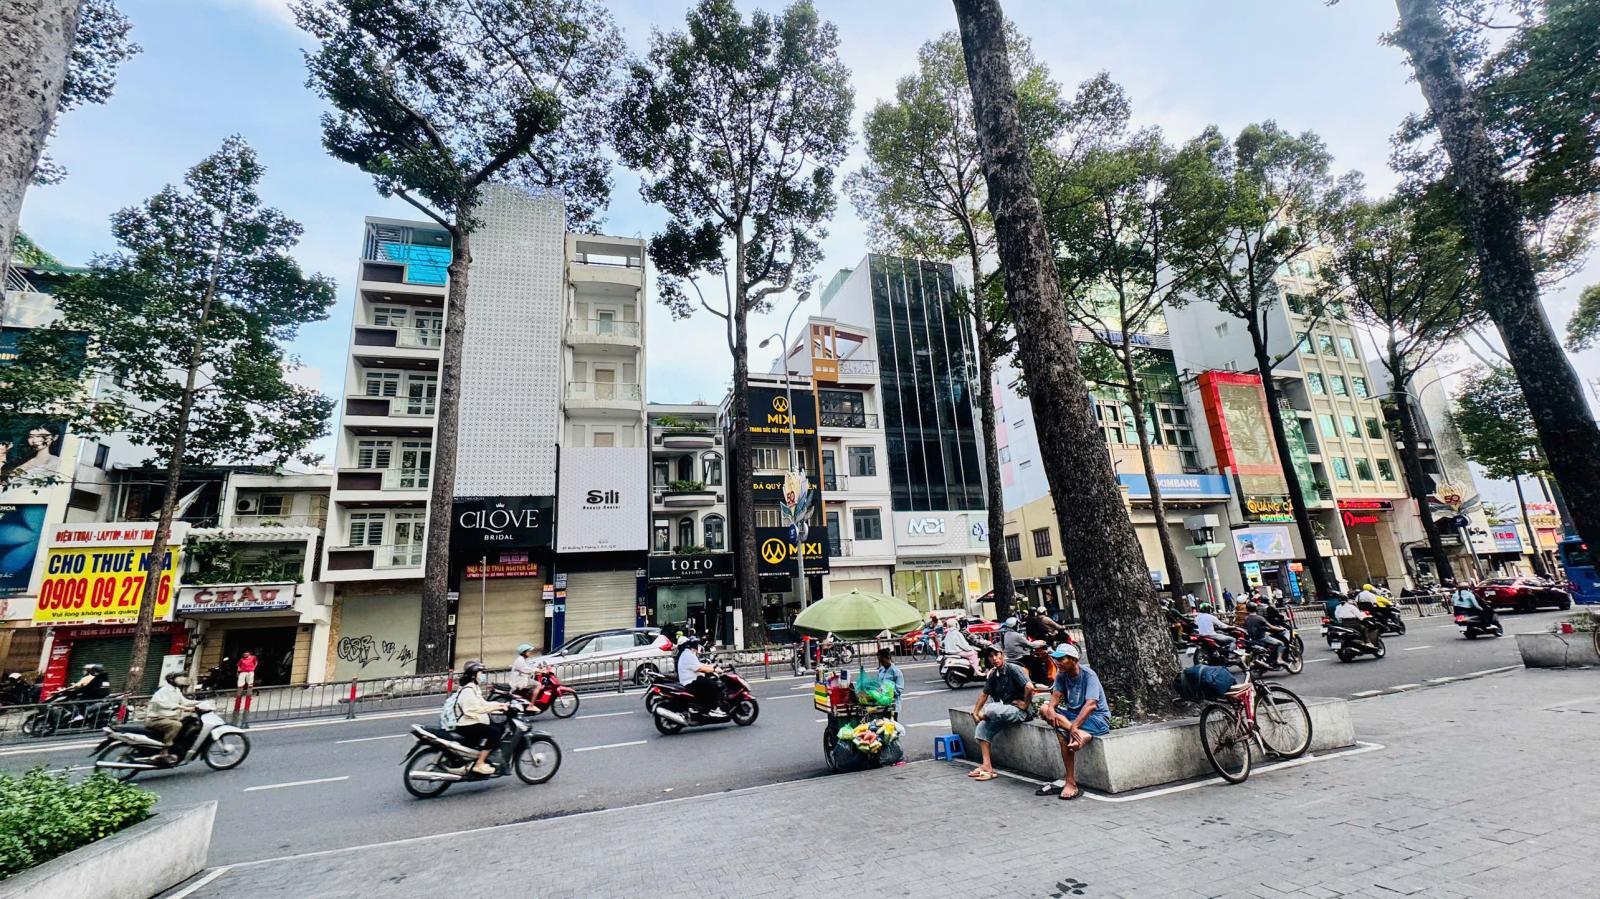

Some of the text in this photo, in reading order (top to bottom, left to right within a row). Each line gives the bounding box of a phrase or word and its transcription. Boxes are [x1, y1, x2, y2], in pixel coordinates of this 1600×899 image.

[767, 413, 796, 425] MIXI
[753, 482, 764, 490] ĐÁ
[766, 482, 780, 490] QUÝ
[1157, 478, 1199, 488] XIMBANK
[586, 490, 619, 504] Sili
[460, 509, 540, 533] CILOVE
[788, 542, 822, 555] MIXI
[48, 549, 172, 574] CHO THUÊ NÀ
[672, 558, 712, 570] toro
[38, 577, 88, 610] 0909
[90, 576, 116, 608] 09
[118, 576, 145, 606] 27
